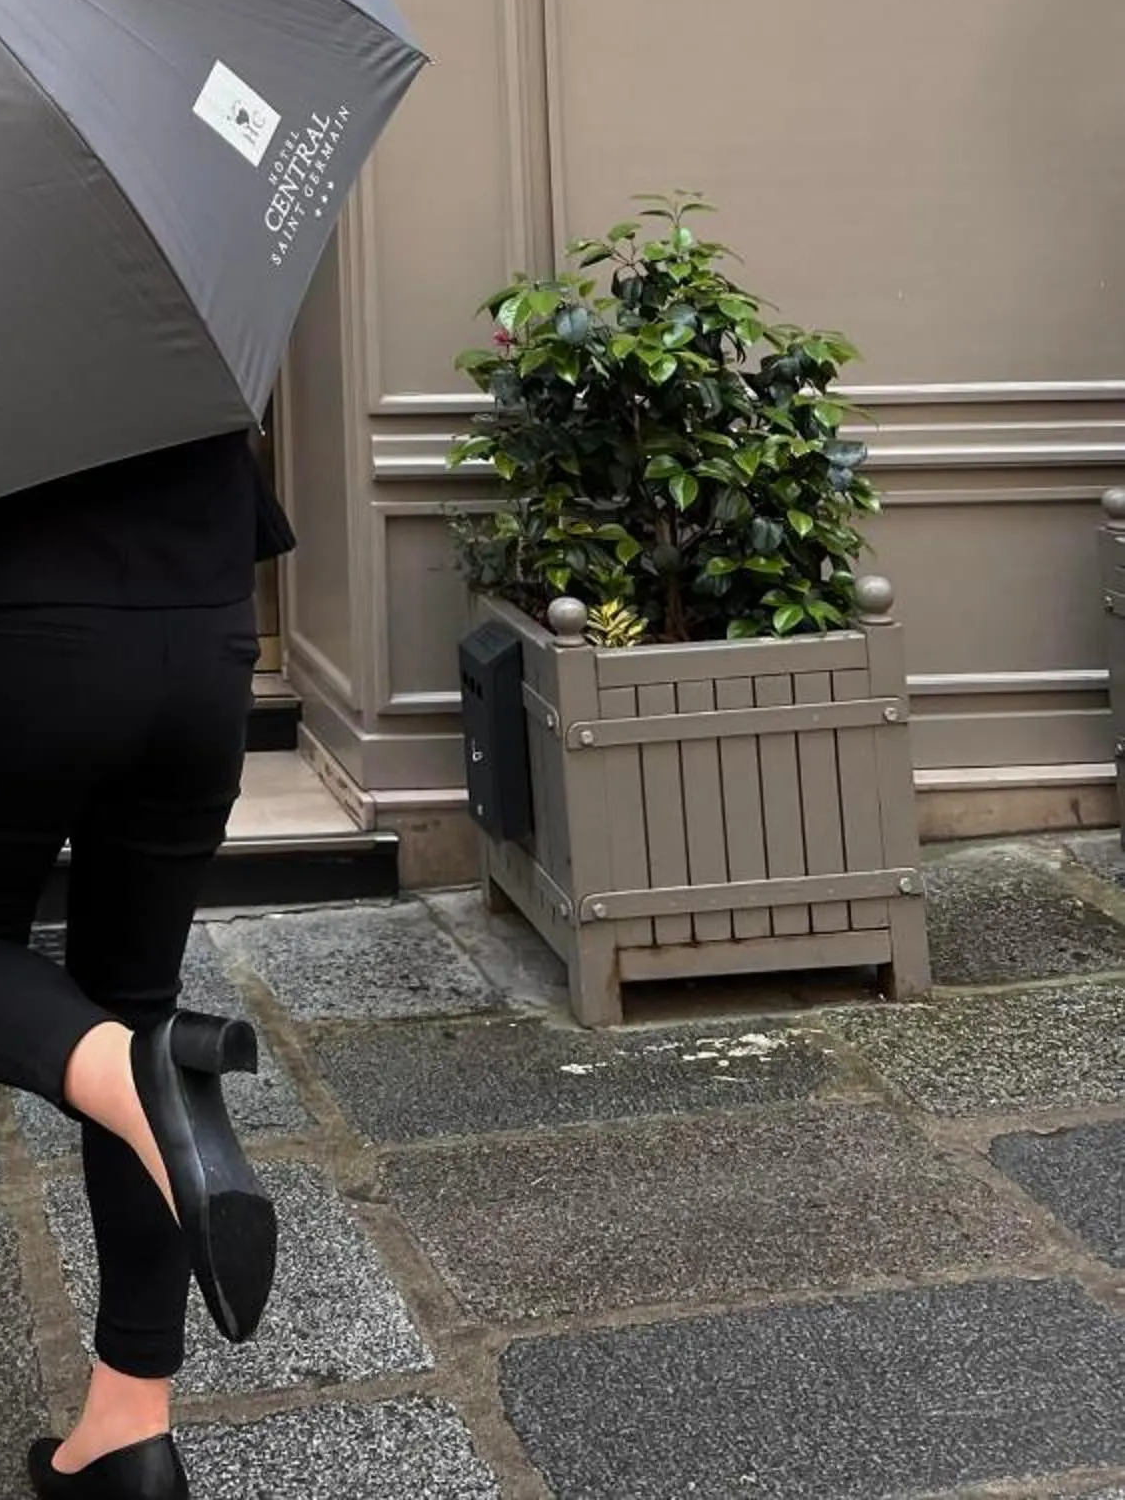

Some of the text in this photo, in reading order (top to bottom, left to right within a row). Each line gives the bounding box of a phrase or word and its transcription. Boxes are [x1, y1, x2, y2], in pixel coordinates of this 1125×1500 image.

[264, 112, 330, 232] CENTRAL
[268, 131, 300, 186] HOTEL
[271, 105, 351, 267] SAINT GERMAIN
